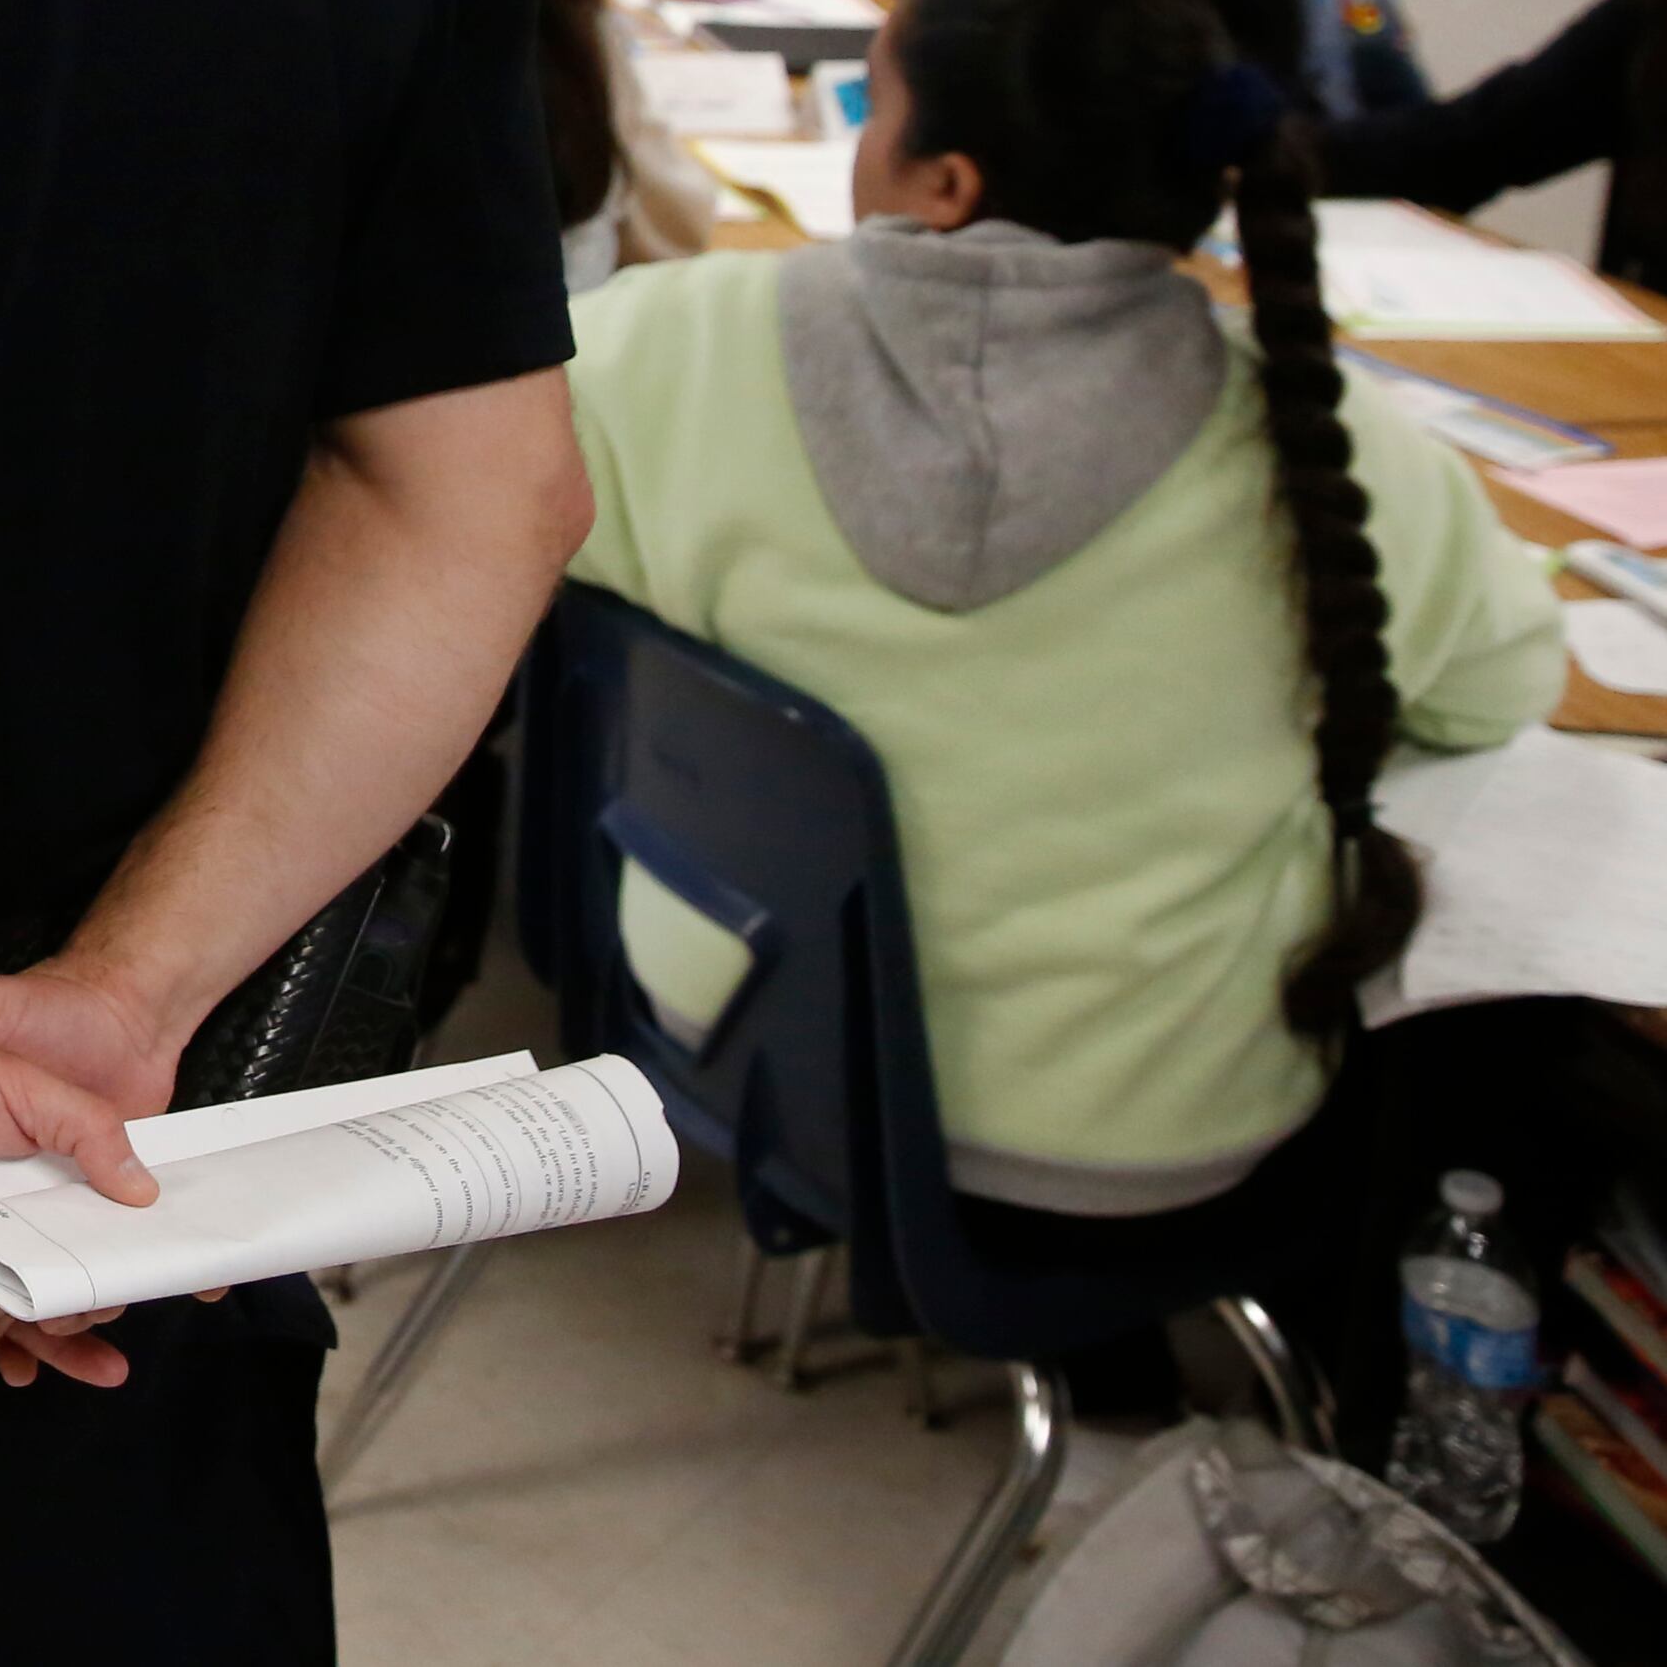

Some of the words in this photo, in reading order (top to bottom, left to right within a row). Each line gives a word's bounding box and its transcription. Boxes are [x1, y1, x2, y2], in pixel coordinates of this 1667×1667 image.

[435, 1143, 448, 1154] on
[449, 1158, 463, 1174] the
[505, 1108, 523, 1124] that
[545, 1173, 553, 1186] or
[537, 1126, 551, 1143] the
[549, 1147, 565, 1203] questions
[569, 1152, 578, 1165] in
[581, 1137, 591, 1150] in
[587, 1151, 599, 1179] their
[408, 1157, 439, 1193] different
[492, 1153, 512, 1189] student
[573, 1167, 583, 1186] the
